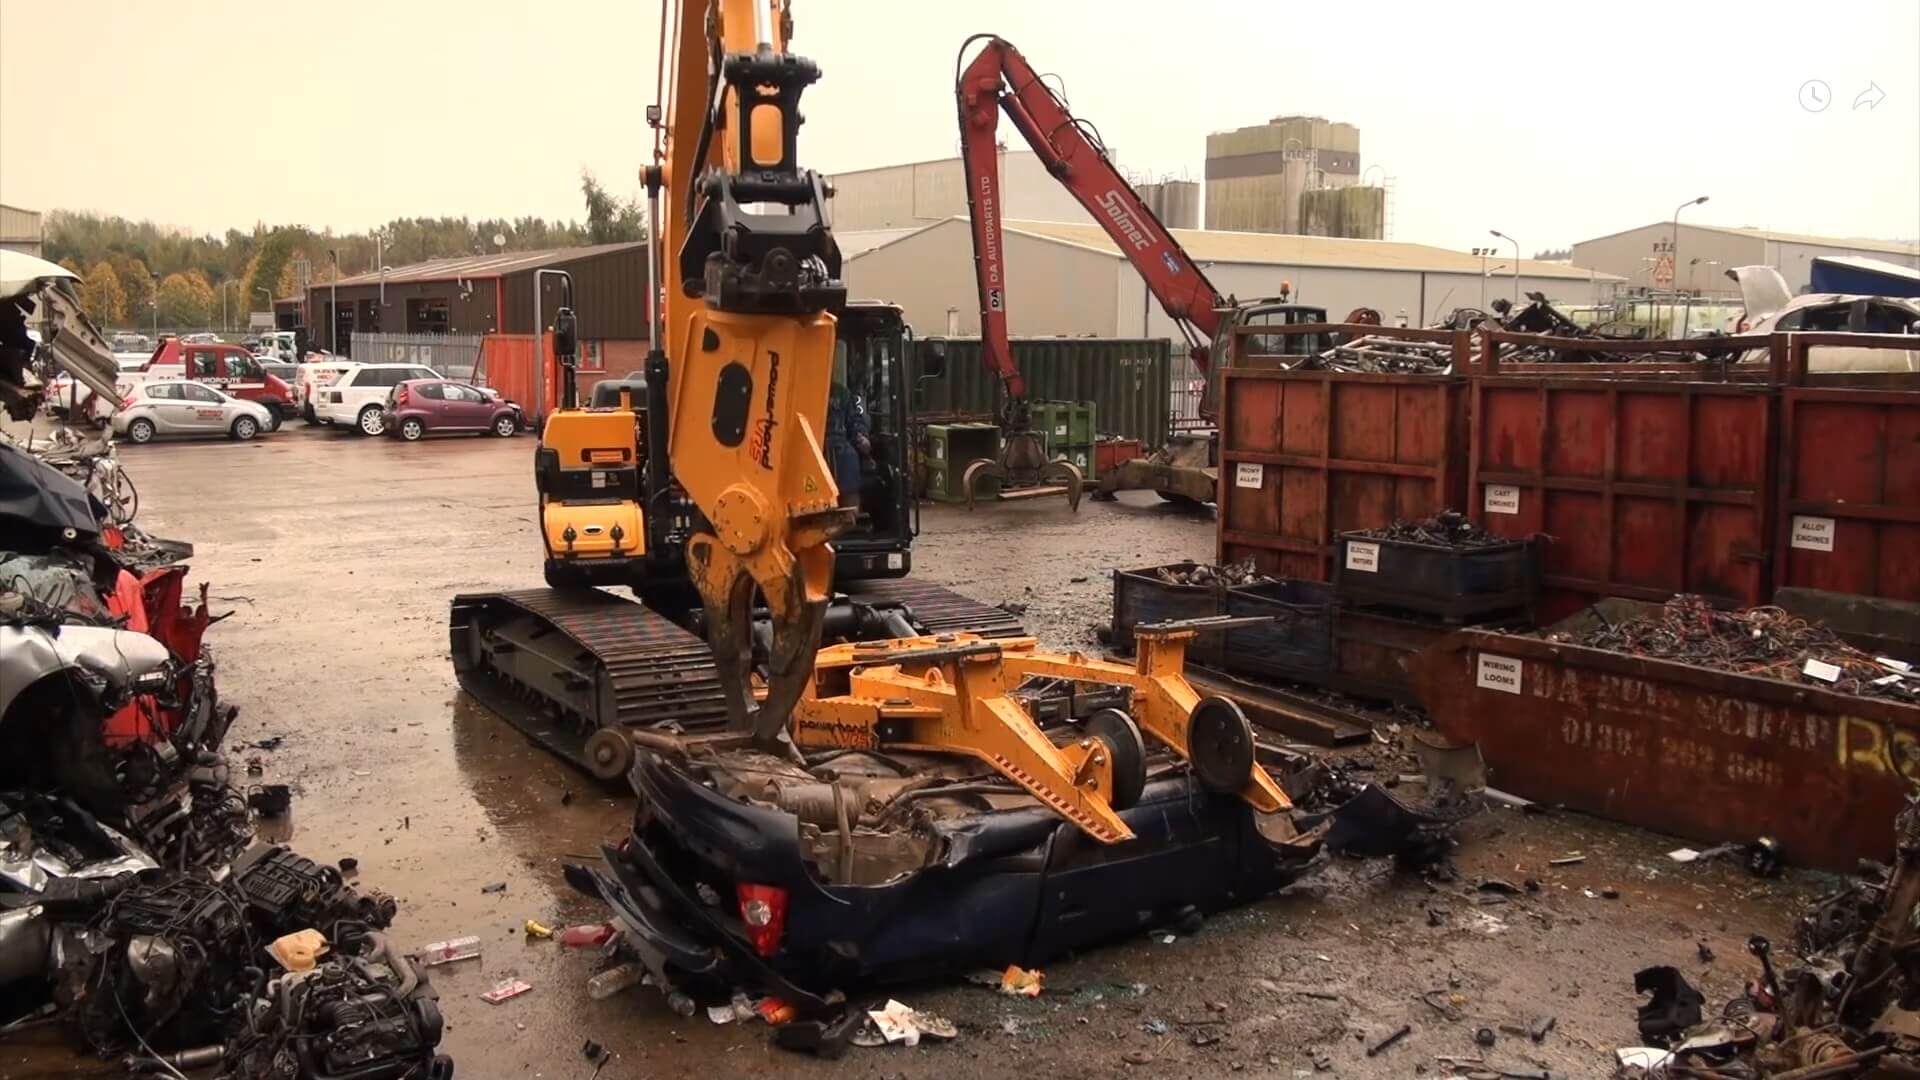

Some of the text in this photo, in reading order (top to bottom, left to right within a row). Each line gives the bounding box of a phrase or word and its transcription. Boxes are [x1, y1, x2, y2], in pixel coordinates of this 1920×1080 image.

[1094, 190, 1157, 251] Solmec
[981, 176, 999, 283] DA AUTOPARTS LTD
[761, 350, 780, 471] powerhand
[1488, 499, 1516, 509] ENGINES
[1801, 522, 1826, 532] ALLOY
[1795, 534, 1830, 545] ENGINES
[1483, 660, 1516, 673] WIRING
[1483, 673, 1515, 686] LOOMS
[799, 717, 869, 737] powerhand
